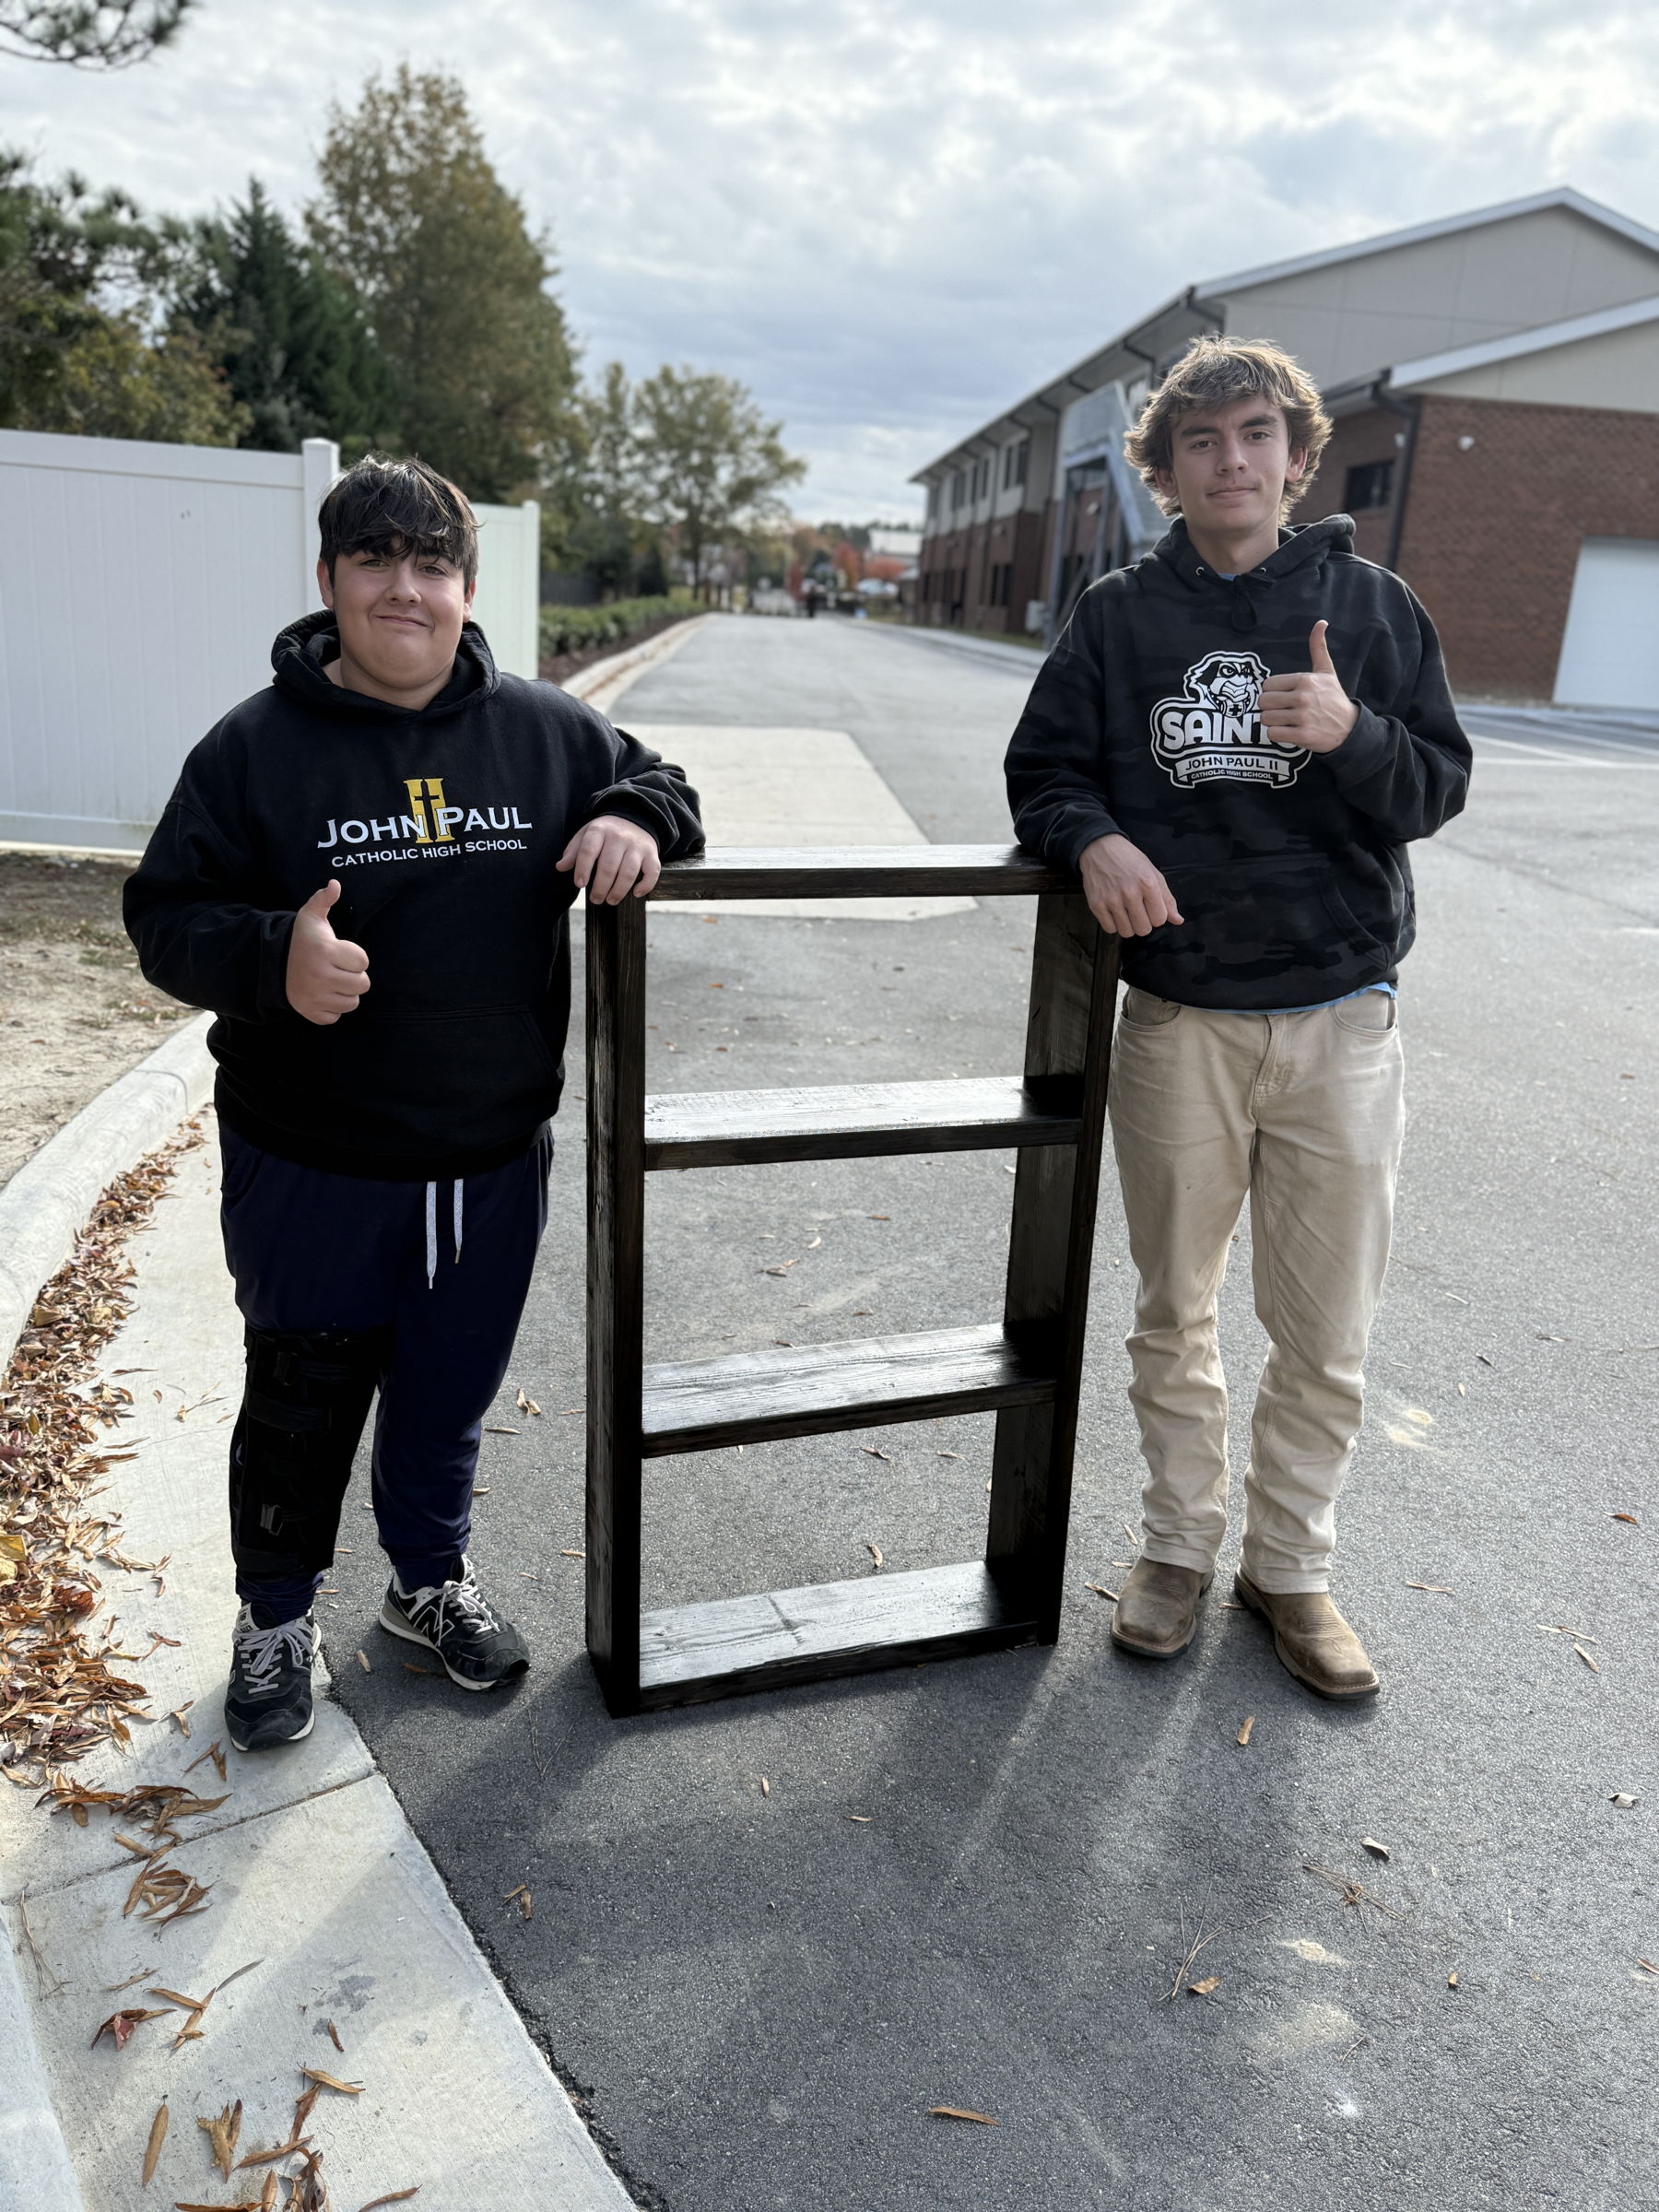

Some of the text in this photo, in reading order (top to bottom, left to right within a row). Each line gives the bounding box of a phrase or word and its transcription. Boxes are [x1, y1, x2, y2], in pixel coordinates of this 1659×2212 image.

[1161, 710, 1296, 750] SAINT
[1185, 757, 1278, 771] JOHN PAUL II
[1191, 769, 1226, 779] CATHOLIC
[1241, 771, 1274, 780] SCHOOL
[317, 806, 533, 849] JOHN PAUL
[331, 839, 527, 868] CATHOLIC HIGH SCHOOL
